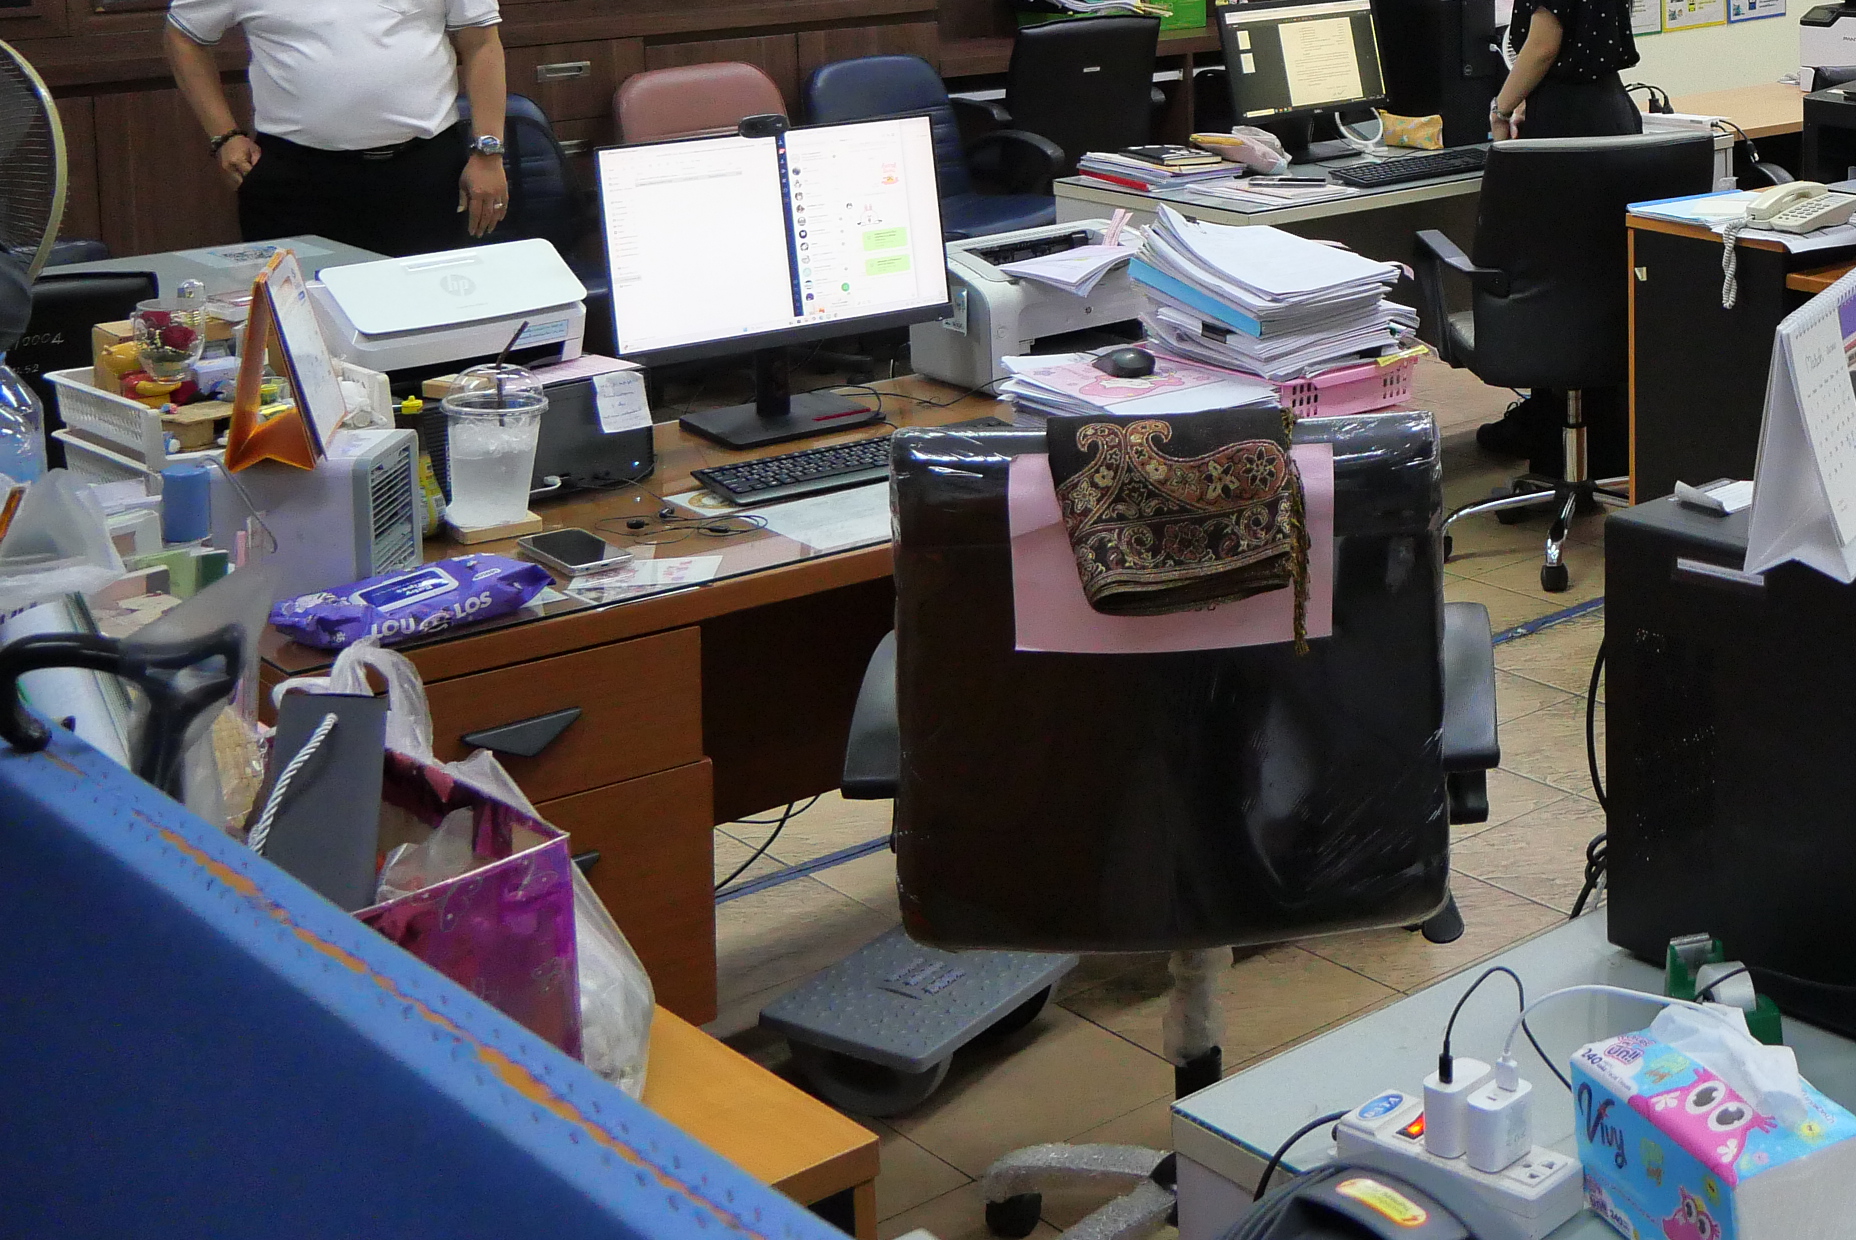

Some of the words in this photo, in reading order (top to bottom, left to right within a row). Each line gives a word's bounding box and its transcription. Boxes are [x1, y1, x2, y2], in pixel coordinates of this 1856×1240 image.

[454, 591, 492, 619] LOS
[370, 617, 416, 639] LOU
[1581, 1048, 1603, 1065] 240
[1577, 1081, 1628, 1170] Vivy
